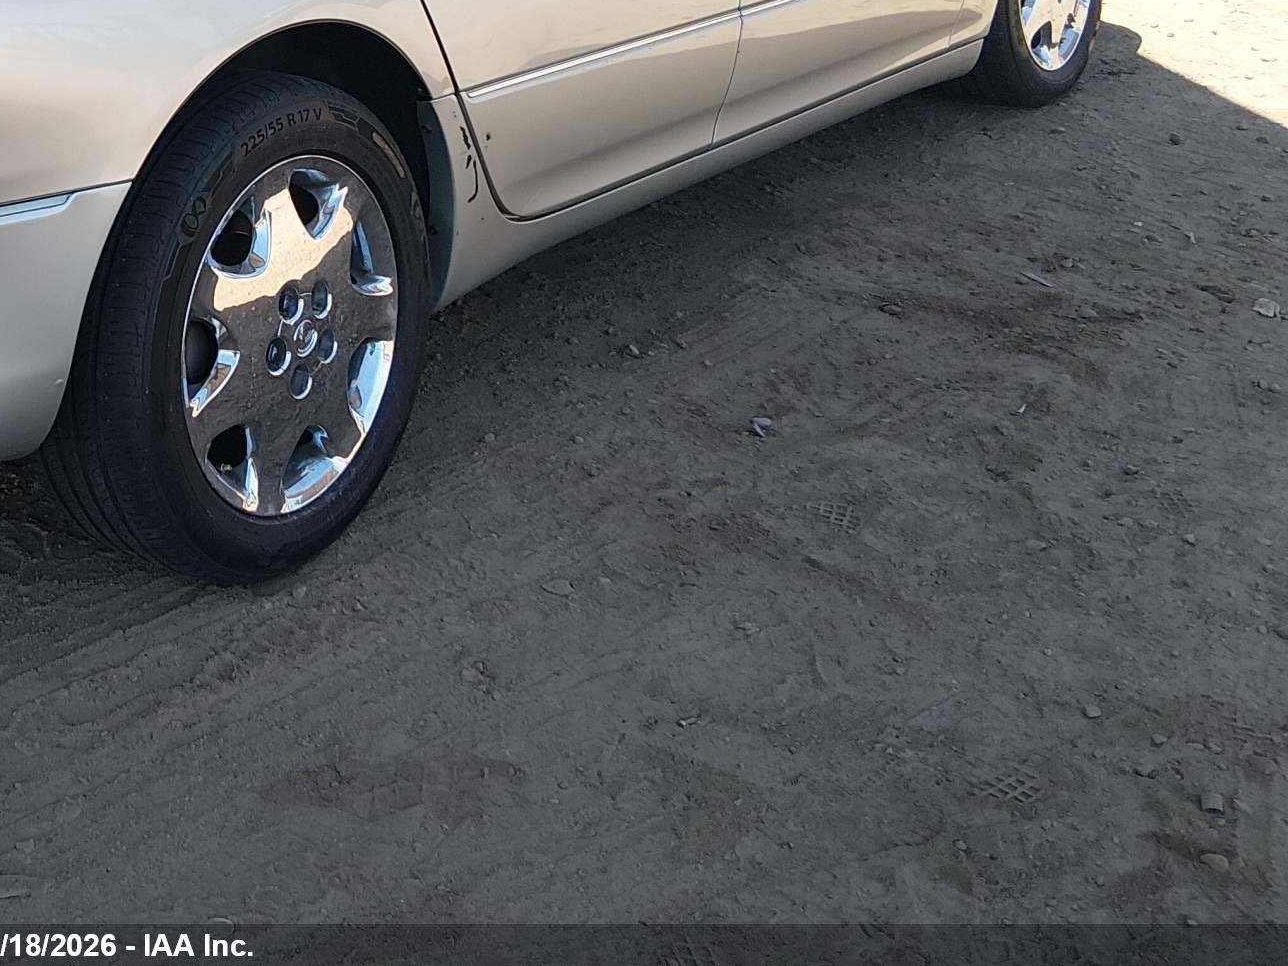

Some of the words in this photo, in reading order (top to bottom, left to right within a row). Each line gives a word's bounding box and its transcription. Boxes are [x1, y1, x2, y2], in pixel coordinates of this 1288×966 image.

[240, 117, 284, 158] 225/55
[286, 113, 297, 127] R
[298, 109, 310, 123] 17
[313, 107, 322, 121] V
